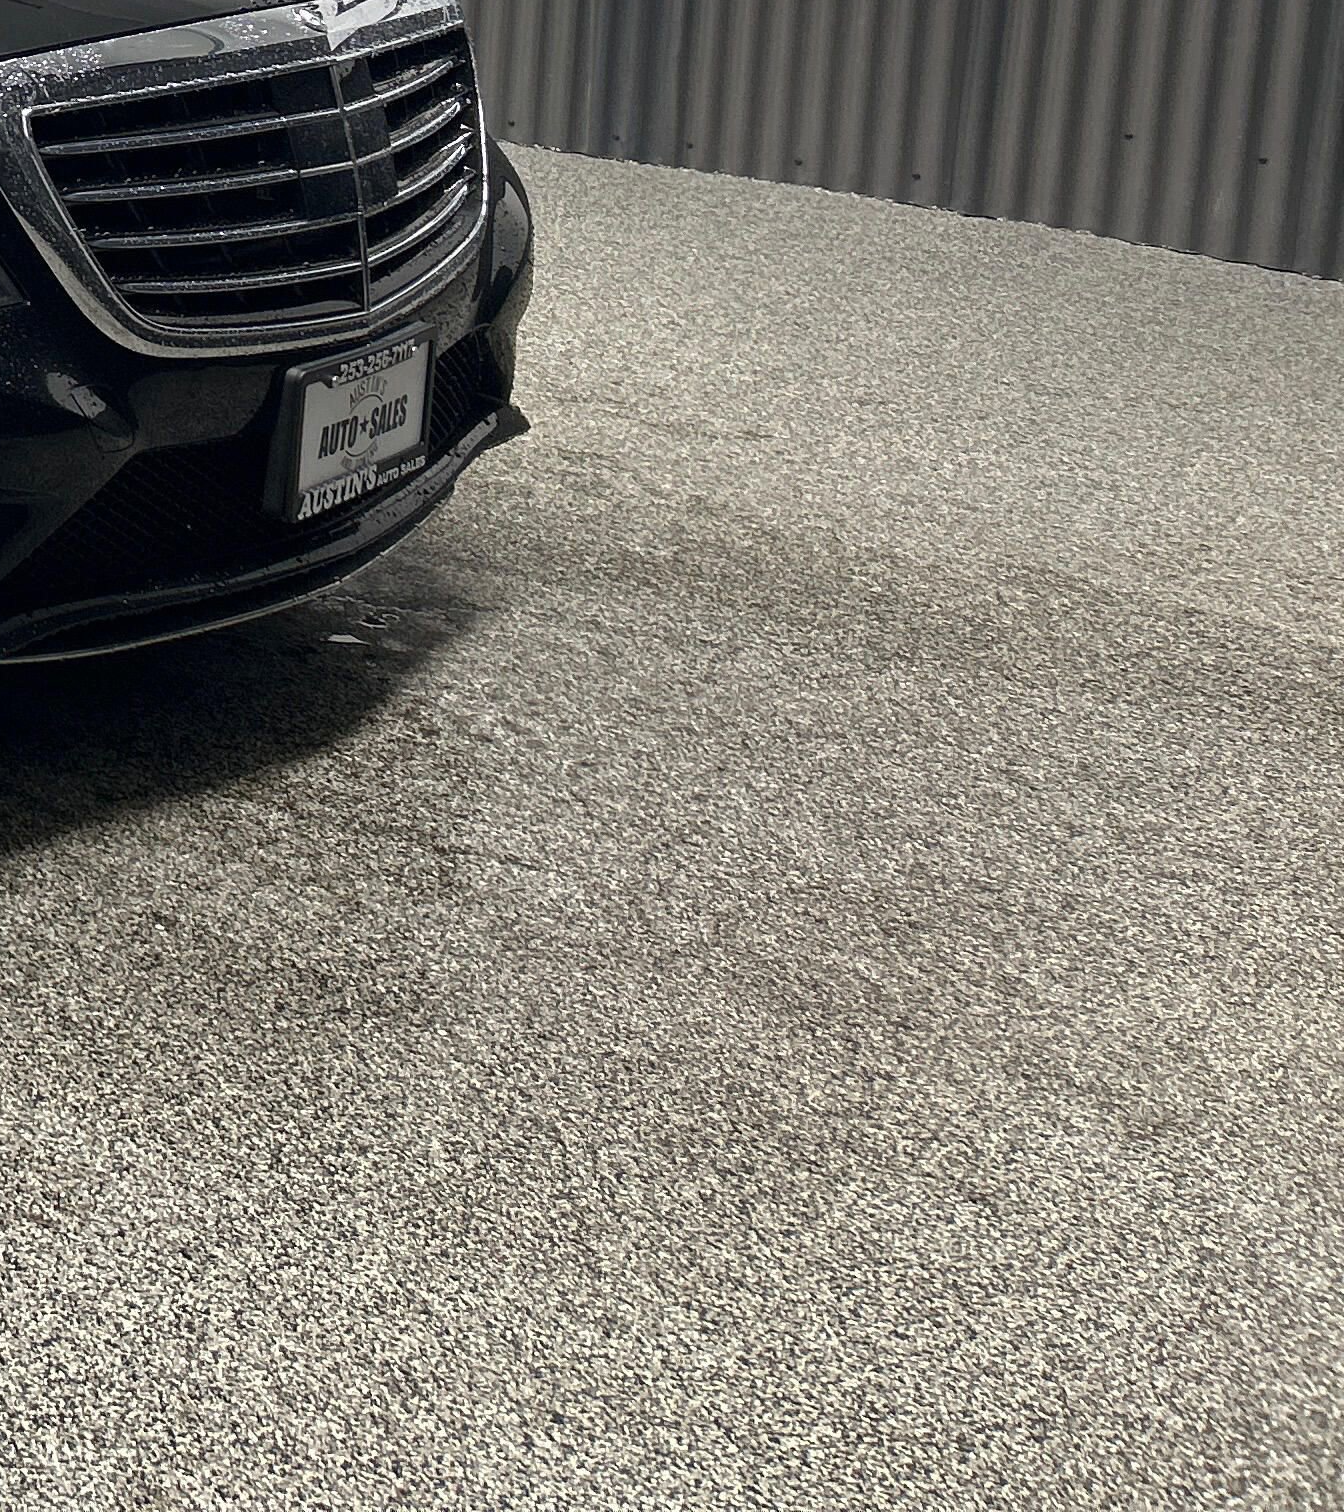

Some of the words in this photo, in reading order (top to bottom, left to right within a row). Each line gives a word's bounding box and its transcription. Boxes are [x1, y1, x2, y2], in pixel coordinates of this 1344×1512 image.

[318, 416, 359, 459] AUTO
[369, 394, 408, 440] SALES
[297, 465, 377, 520] AUSTIN'S
[377, 467, 399, 487] AUTO
[400, 455, 426, 475] SALES
